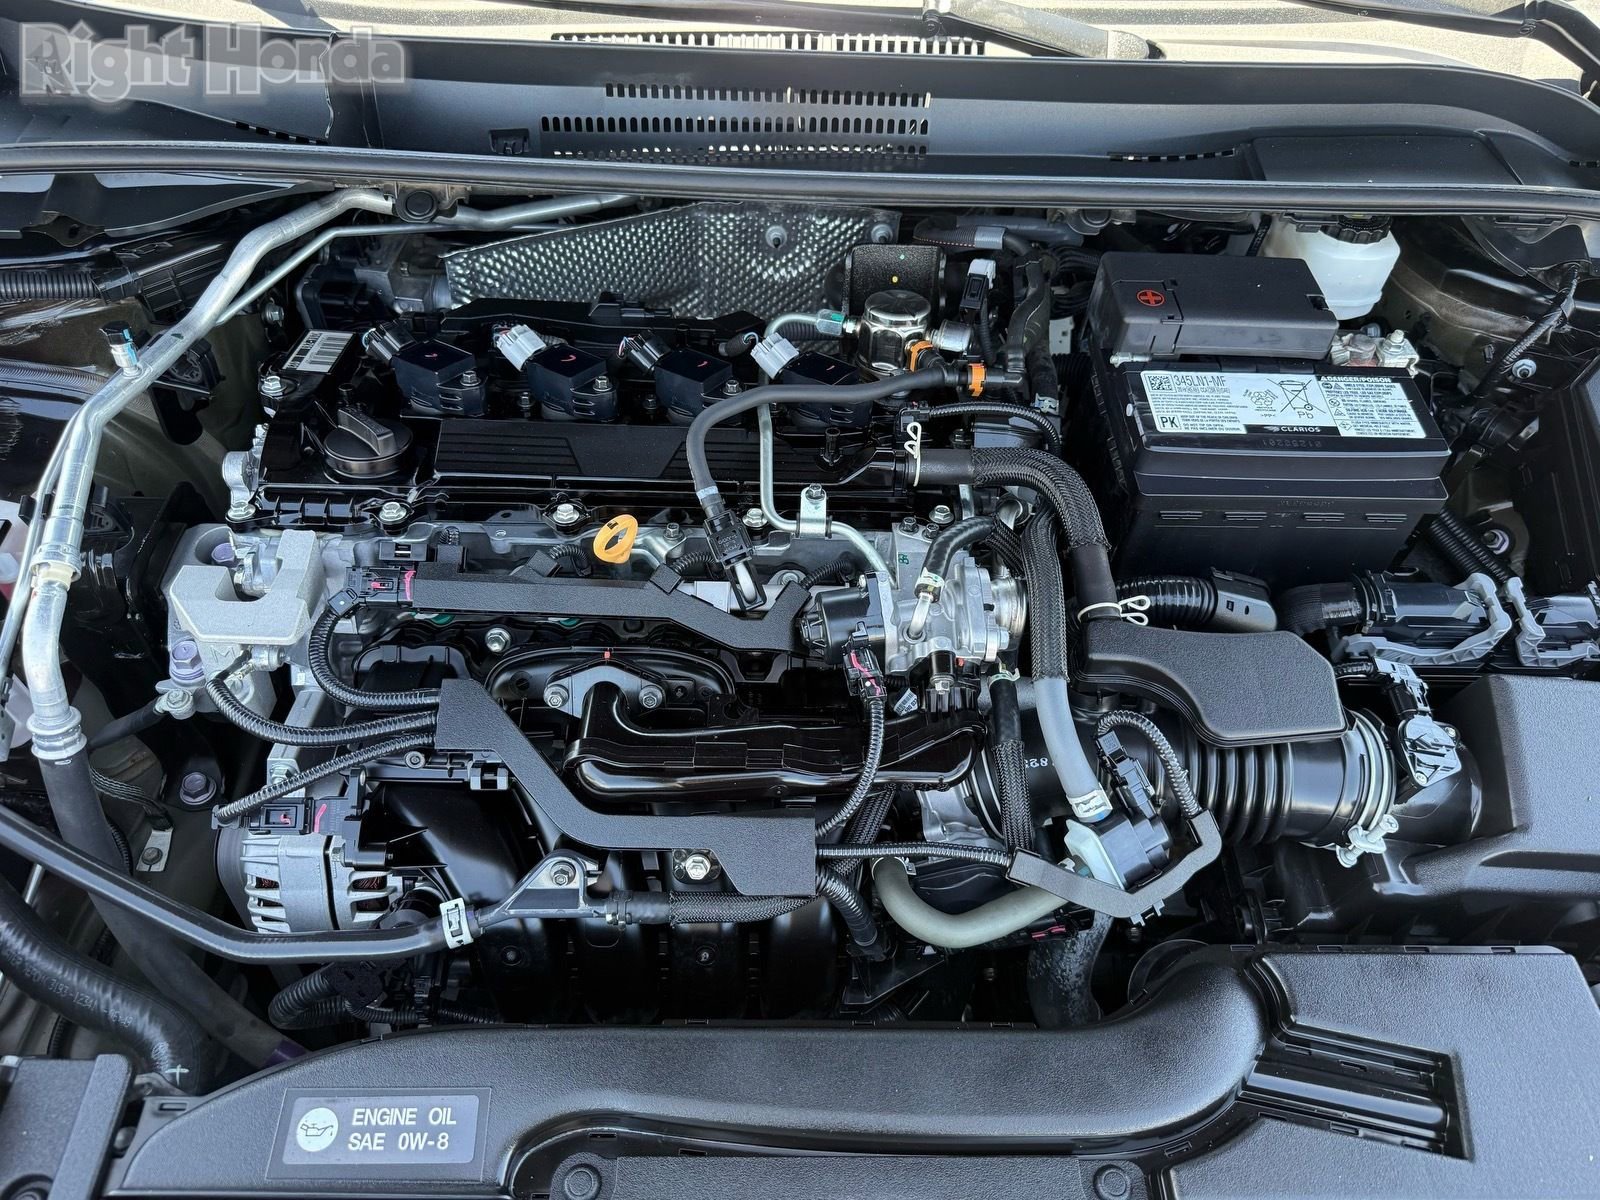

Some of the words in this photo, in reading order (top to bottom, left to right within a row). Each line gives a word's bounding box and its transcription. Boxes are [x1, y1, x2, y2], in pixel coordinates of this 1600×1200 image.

[1173, 374, 1226, 387] 345LN1-MF
[1296, 411, 1314, 419] Pb
[1160, 416, 1179, 429] PK
[351, 1107, 418, 1126] ENGINE
[428, 1107, 457, 1125] OIL
[347, 1132, 386, 1151] SAE
[398, 1132, 450, 1151] 0W-8
